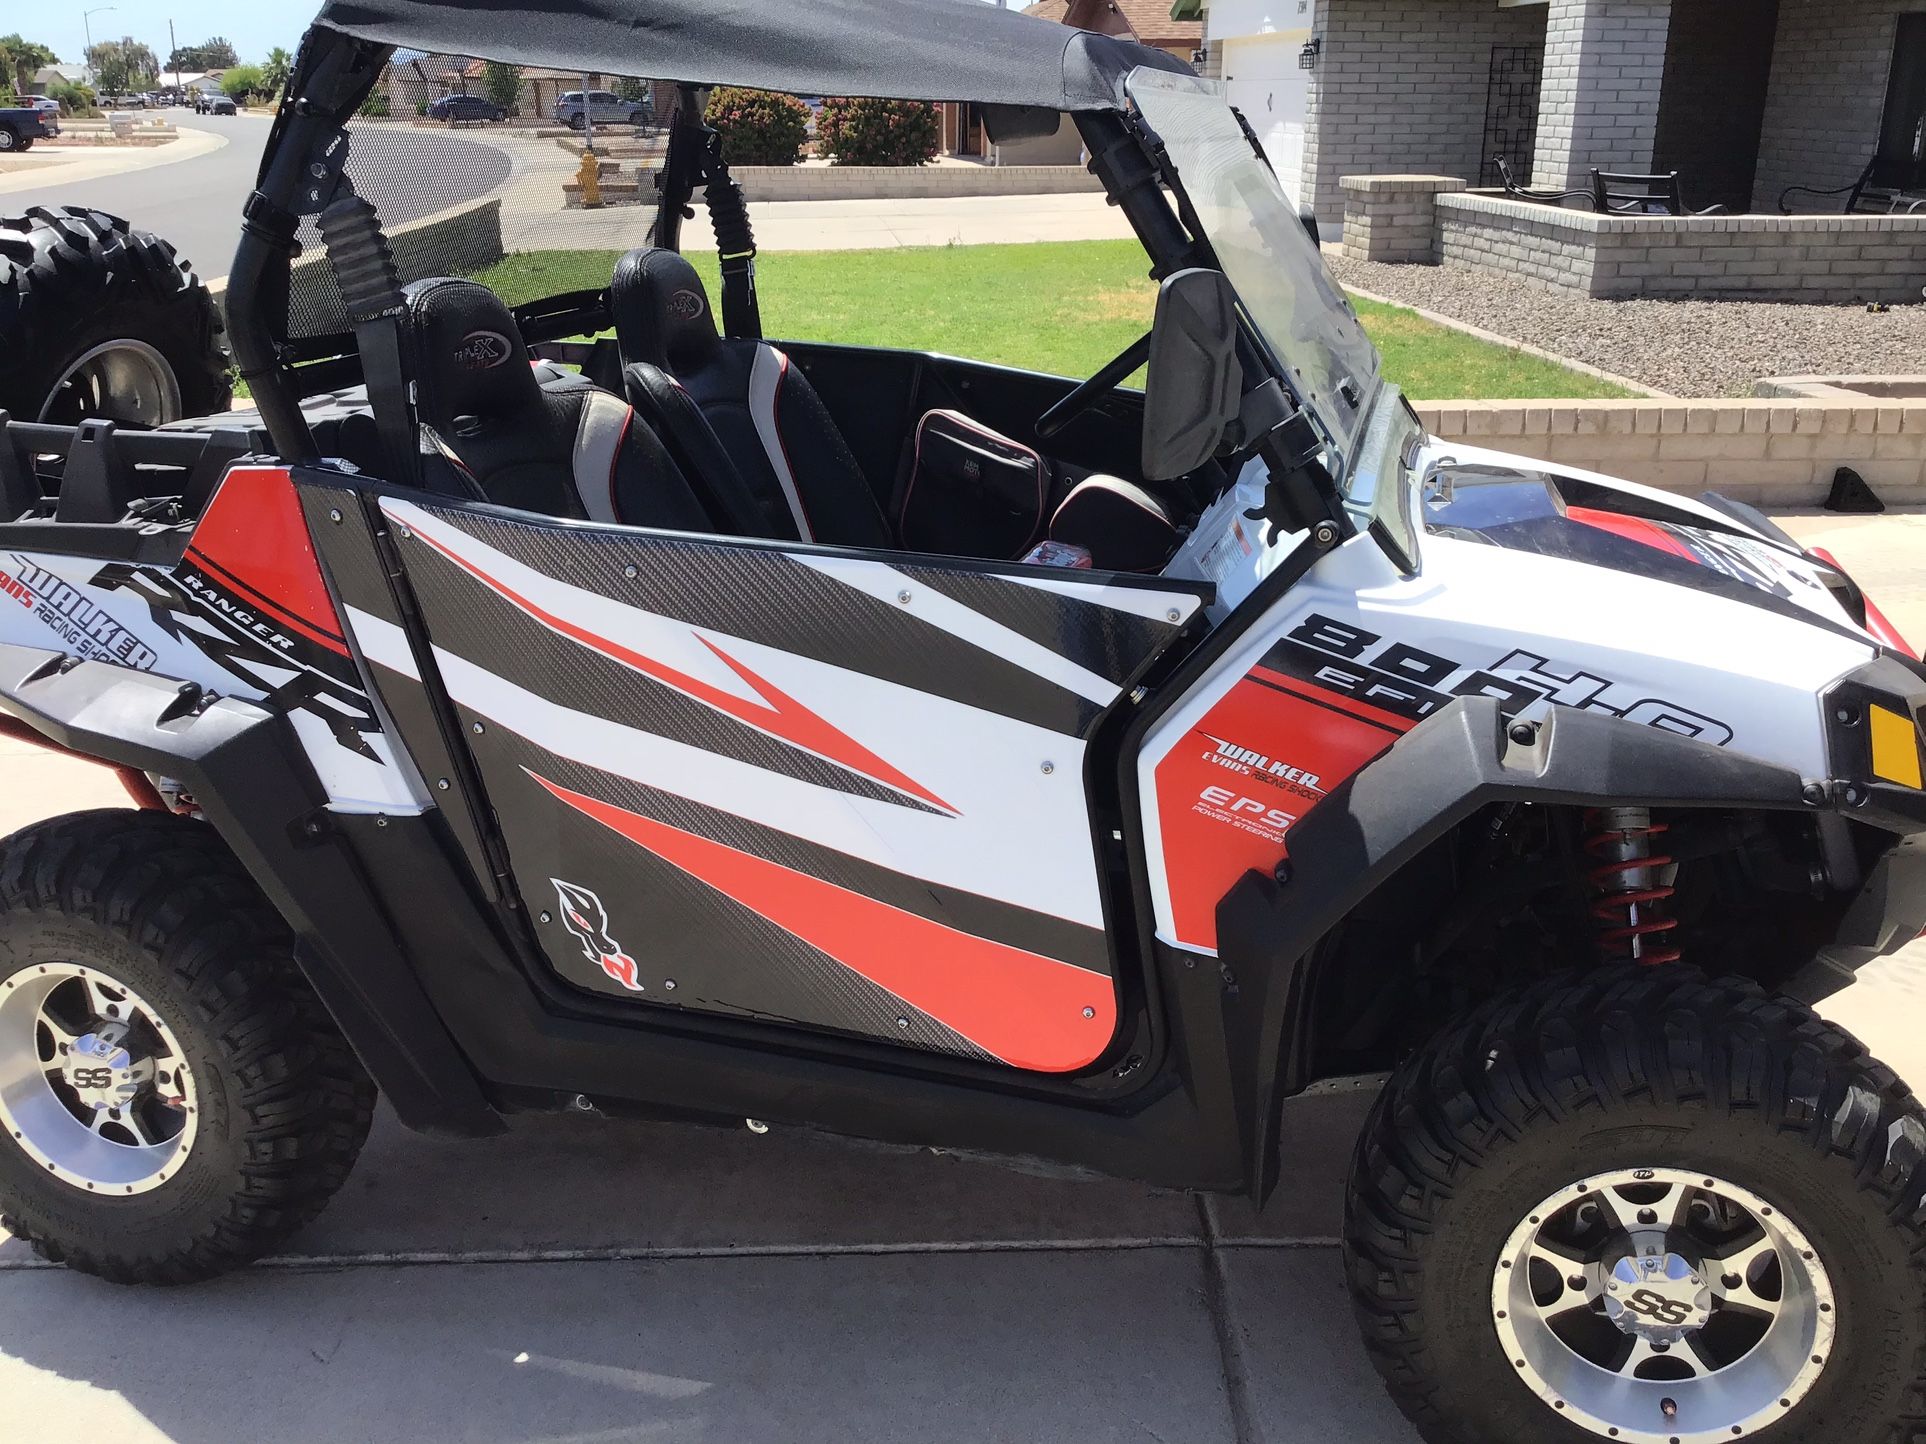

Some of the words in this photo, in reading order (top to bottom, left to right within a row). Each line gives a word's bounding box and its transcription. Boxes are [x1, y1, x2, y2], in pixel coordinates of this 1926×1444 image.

[10, 553, 158, 672] WALKER
[33, 602, 81, 645] RACING
[183, 574, 296, 650] RANGER
[1313, 665, 1434, 715] EFI
[1194, 730, 1328, 795] WALKER
[1201, 750, 1251, 775] EVANS
[1250, 770, 1290, 791] RACING
[1191, 804, 1232, 824] POWER
[1231, 820, 1285, 844] STEERING
[1200, 785, 1297, 829] EPS
[73, 1067, 112, 1089] SS
[1623, 1288, 1693, 1325] SS
